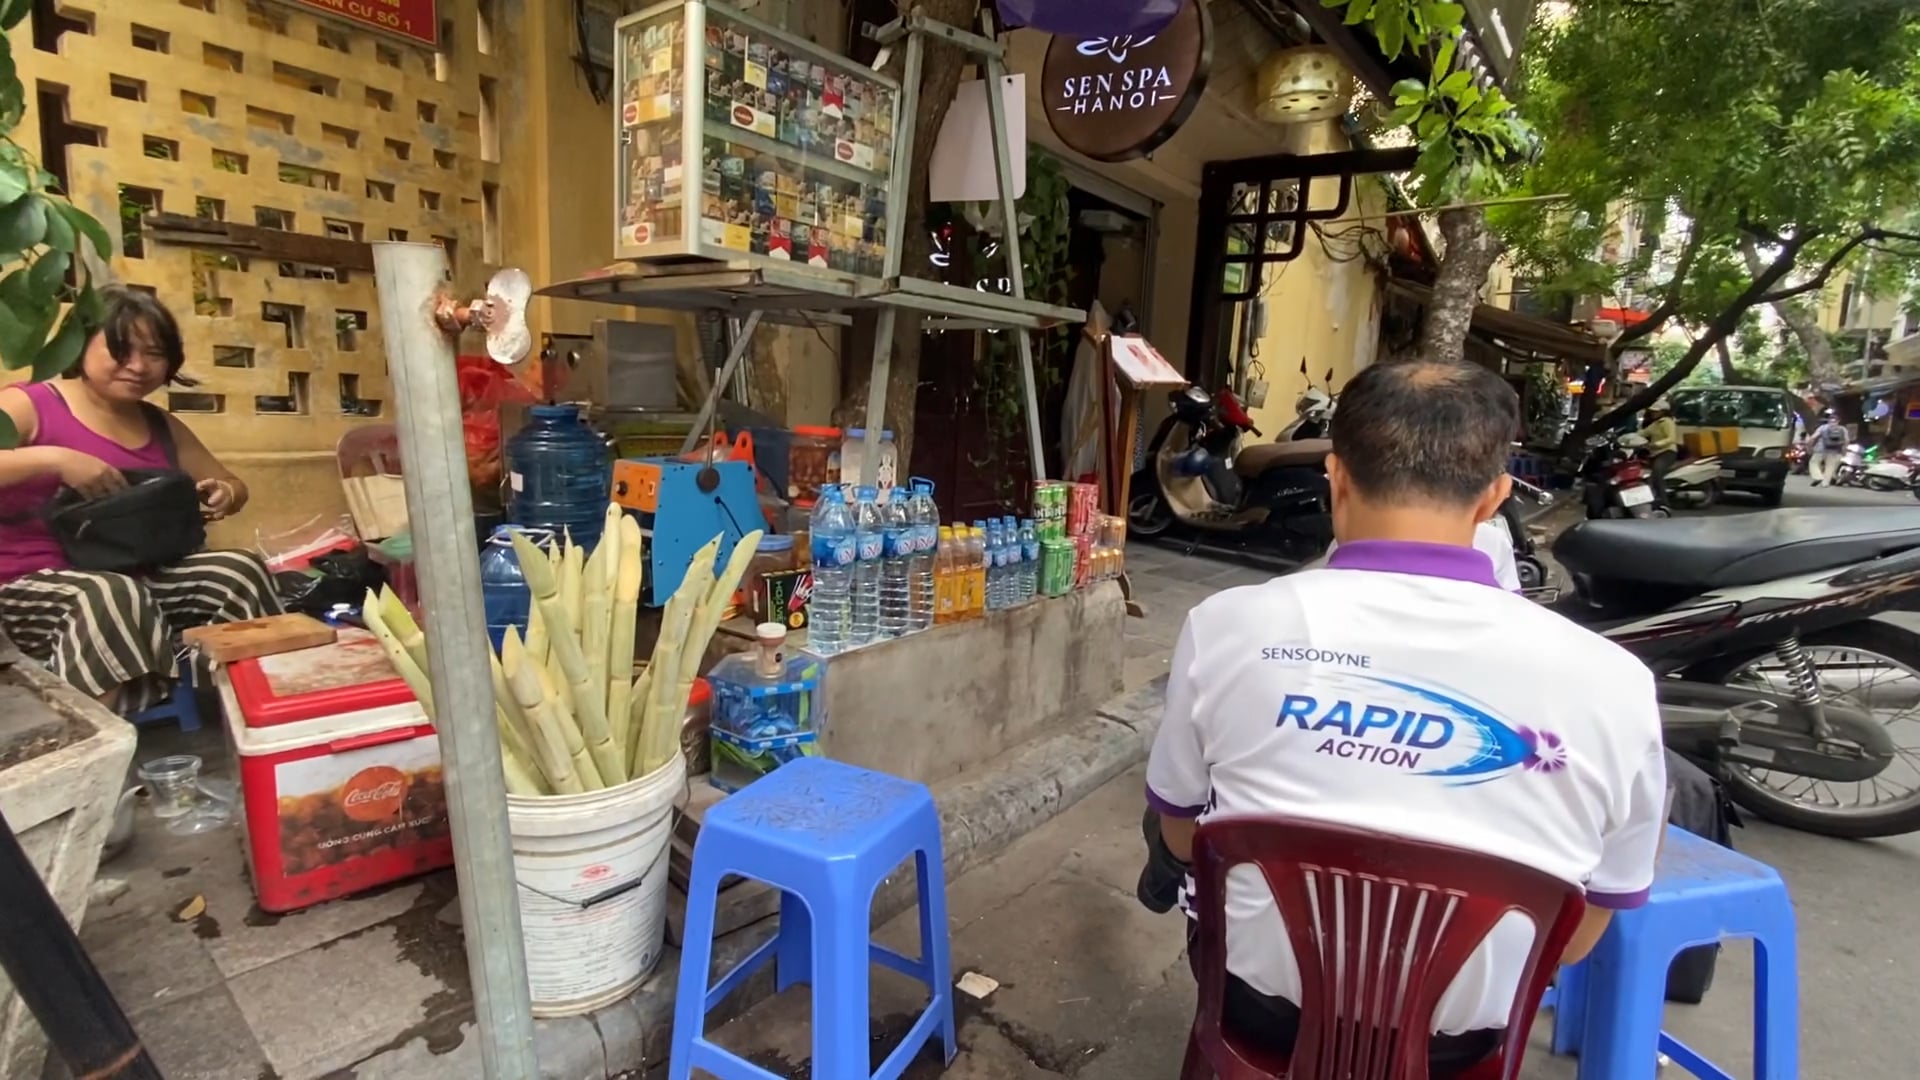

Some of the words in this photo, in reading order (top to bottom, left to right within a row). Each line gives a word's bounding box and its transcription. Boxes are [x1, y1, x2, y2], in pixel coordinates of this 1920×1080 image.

[1063, 73, 1113, 98] SEN
[1121, 65, 1172, 91] SPA
[1074, 90, 1156, 114] HANOI
[1261, 647, 1371, 669] SENSODYNE
[1275, 694, 1455, 749] RAPID
[1316, 738, 1421, 769] ACTION
